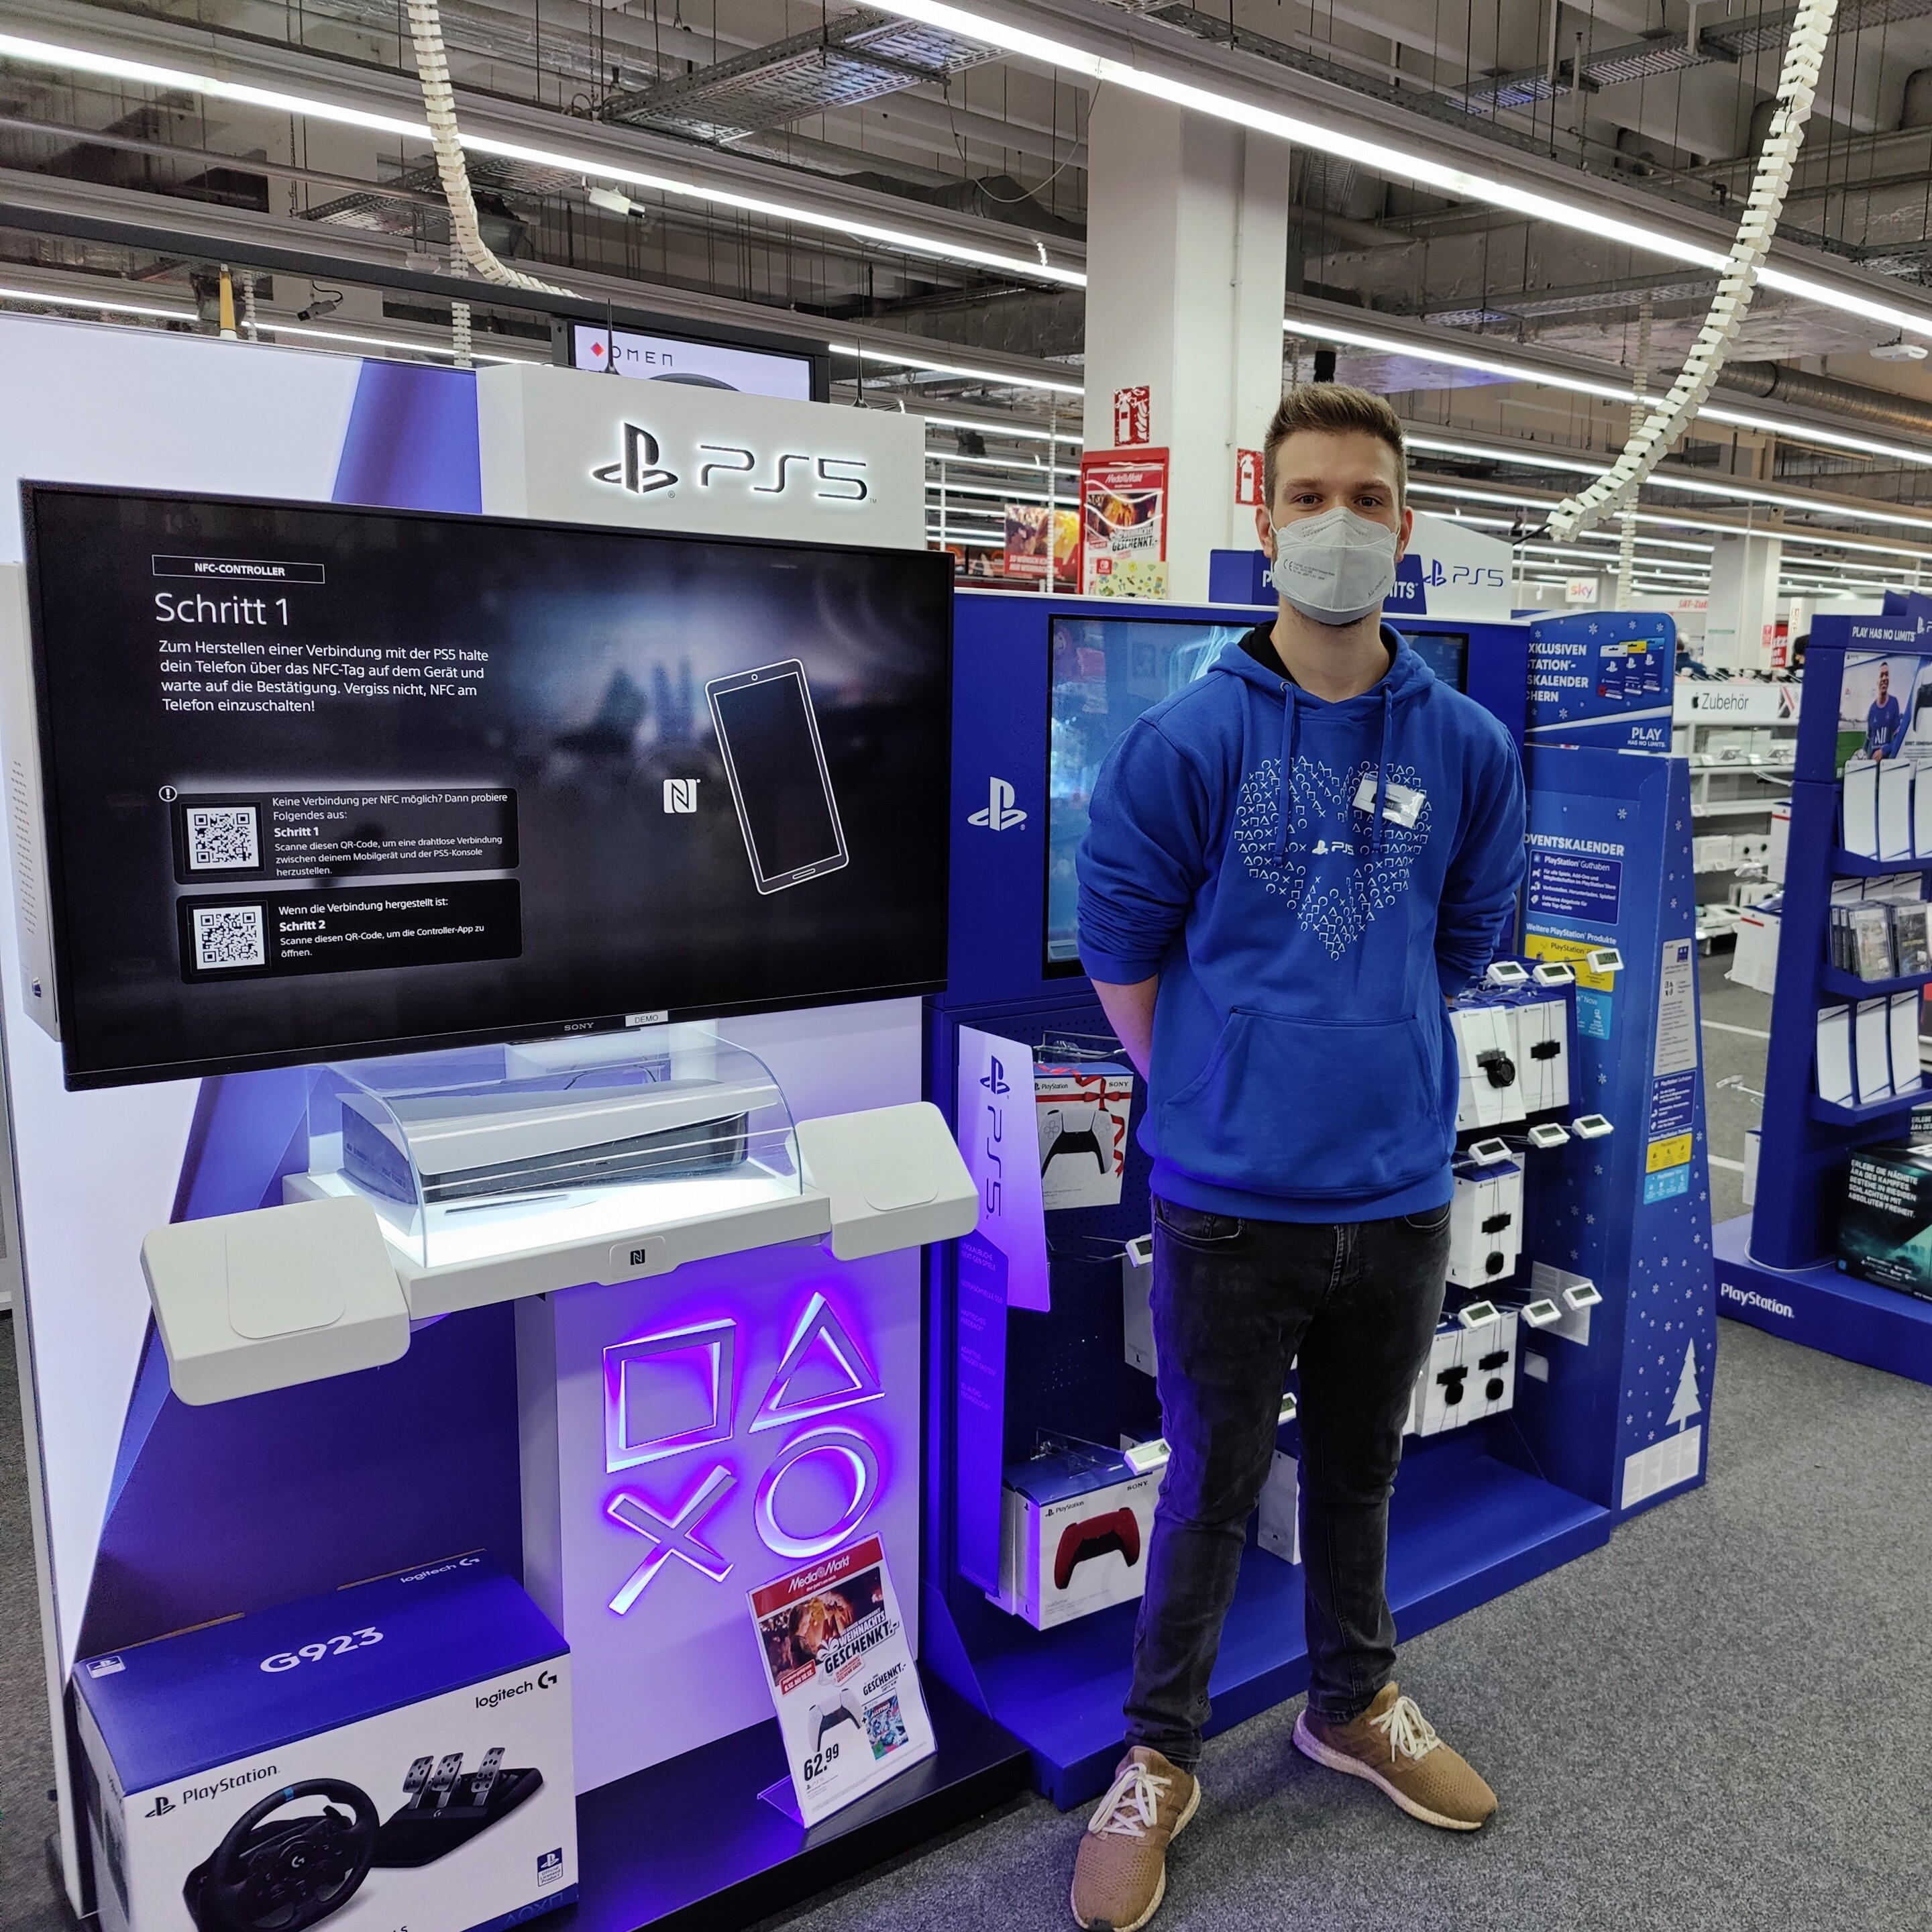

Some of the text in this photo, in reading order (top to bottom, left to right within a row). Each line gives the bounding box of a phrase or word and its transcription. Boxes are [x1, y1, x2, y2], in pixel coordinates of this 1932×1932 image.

[697, 444, 868, 500] PS5
[195, 563, 285, 576] NFC-CONTROLLER
[1453, 566, 1503, 587] PS5
[1570, 584, 1595, 599] sky
[155, 592, 288, 626] Schritt 1
[1852, 626, 1868, 638] PLAY
[1869, 627, 1882, 639] HAS
[1884, 629, 1893, 639] NO
[159, 640, 488, 661] Zum Herstellen einer Verbindung mit der PS5 halte
[160, 660, 484, 678] dein Telefon über das NFC-Tag auf dem Gerät und
[161, 680, 477, 696] warte auf die Bestätigung. Vergiss nicht, NFC am
[162, 698, 315, 712] Telefon einzuschalten!
[1701, 692, 1749, 710] Zubehör
[1631, 727, 1662, 741] PLAY
[272, 793, 508, 806] Keine Verbindung per NFC möglich? Dann probiere
[273, 810, 347, 822] Folgendes aus:
[274, 826, 319, 837] Schritt 1
[274, 843, 307, 851] Scanne
[309, 841, 338, 850] diesen
[340, 840, 380, 849] QR-Code,
[398, 839, 416, 847] eine
[418, 837, 455, 846] drahtlose
[457, 836, 502, 845] Verbindung
[1332, 841, 1354, 855] PS5
[276, 848, 482, 864] zwischen deinem Mobilgerät und der PS5-Konsole
[276, 867, 332, 876] herzustellen.
[1580, 861, 1610, 871] Guthaben
[278, 898, 448, 915] Wenn die Verbindung hergestellt ist:
[279, 920, 326, 932] Schritt 2
[1526, 922, 1549, 934] Weitere
[1587, 932, 1617, 945] Produkte
[280, 937, 313, 946] Scanne
[315, 934, 343, 943] diesen
[345, 931, 384, 941] QR-Code,
[402, 929, 415, 937] die
[417, 926, 474, 936] Controller-App
[281, 949, 313, 958] öffnen.
[564, 1022, 594, 1031] SONY
[635, 1014, 659, 1024] DEMO
[987, 1105, 1002, 1217] PS5
[1721, 1283, 1792, 1318] PlayStation
[1127, 1481, 1148, 1491] SONY
[1055, 1500, 1084, 1513] PlayStation
[400, 1562, 457, 1584] logitech
[838, 1610, 886, 1648] WEIHNACHTS
[260, 1626, 384, 1672] G923
[475, 1680, 533, 1708] logitech
[804, 1743, 839, 1781] 62.99
[182, 1765, 277, 1805] PlayStation
